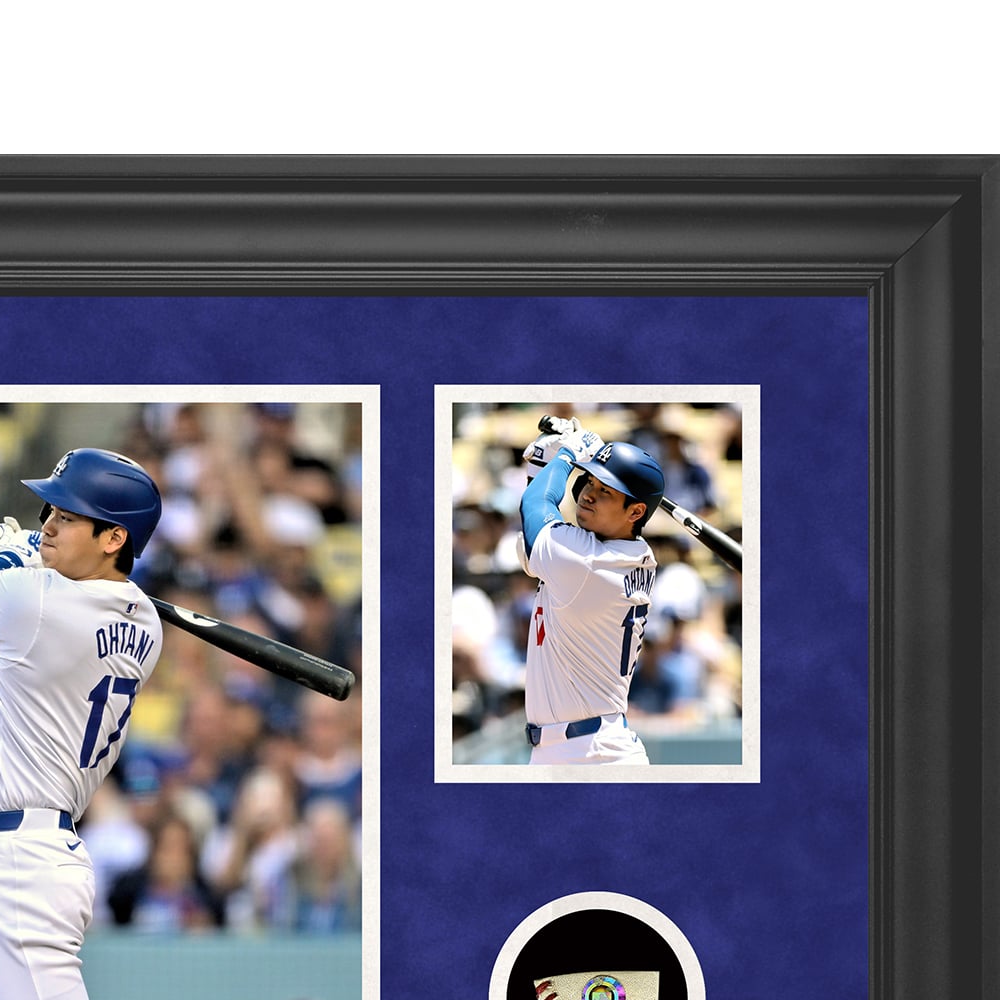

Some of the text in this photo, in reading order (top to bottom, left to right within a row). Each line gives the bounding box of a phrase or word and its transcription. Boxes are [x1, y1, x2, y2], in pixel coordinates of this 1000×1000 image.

[624, 567, 656, 598] OHTANI
[95, 622, 155, 666] OHTANI
[80, 675, 141, 769] 17
